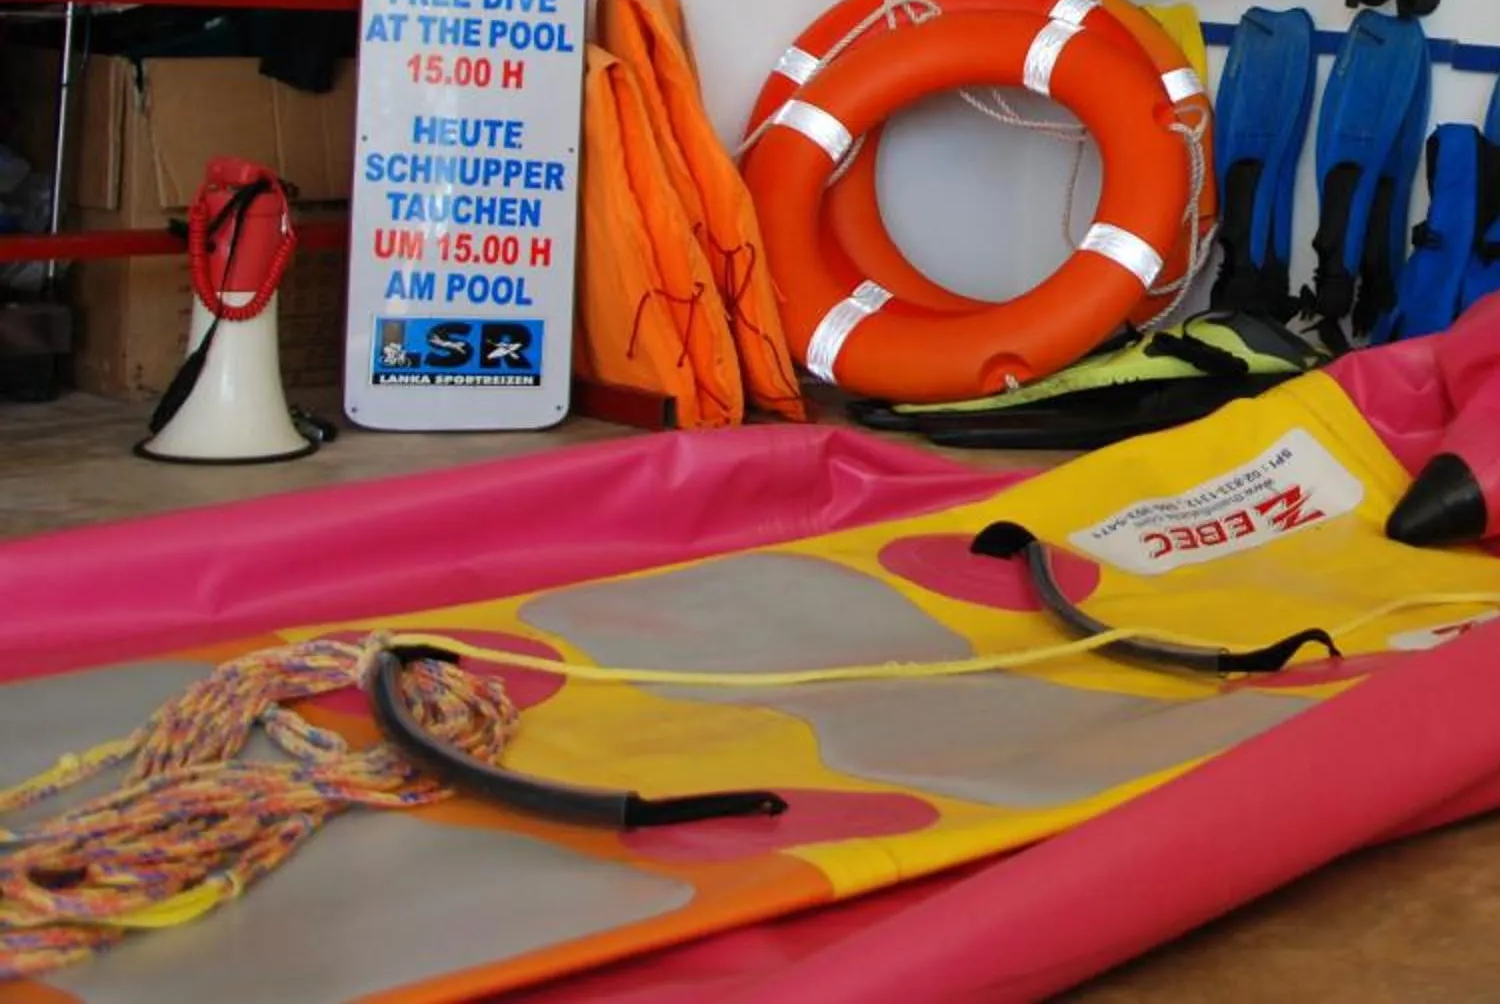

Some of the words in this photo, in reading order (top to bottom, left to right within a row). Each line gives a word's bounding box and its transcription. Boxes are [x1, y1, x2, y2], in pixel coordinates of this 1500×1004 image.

[366, 13, 408, 42] AT
[418, 15, 482, 47] THE
[489, 19, 574, 52] POOL
[408, 53, 491, 88] 15.00
[502, 59, 525, 89] H
[412, 115, 524, 149] HEUTE
[365, 153, 565, 191] SCHNUPPER
[386, 192, 541, 227] TAUCHEN
[374, 228, 423, 260] UM
[437, 232, 519, 265] 15.00
[530, 237, 552, 267] H
[385, 270, 435, 301] AM
[446, 273, 533, 306] POOL
[381, 322, 534, 369] LSR
[379, 374, 430, 385] LANKA
[434, 375, 535, 386] SPORTREIZEN
[1141, 483, 1327, 559] ZEBEC
